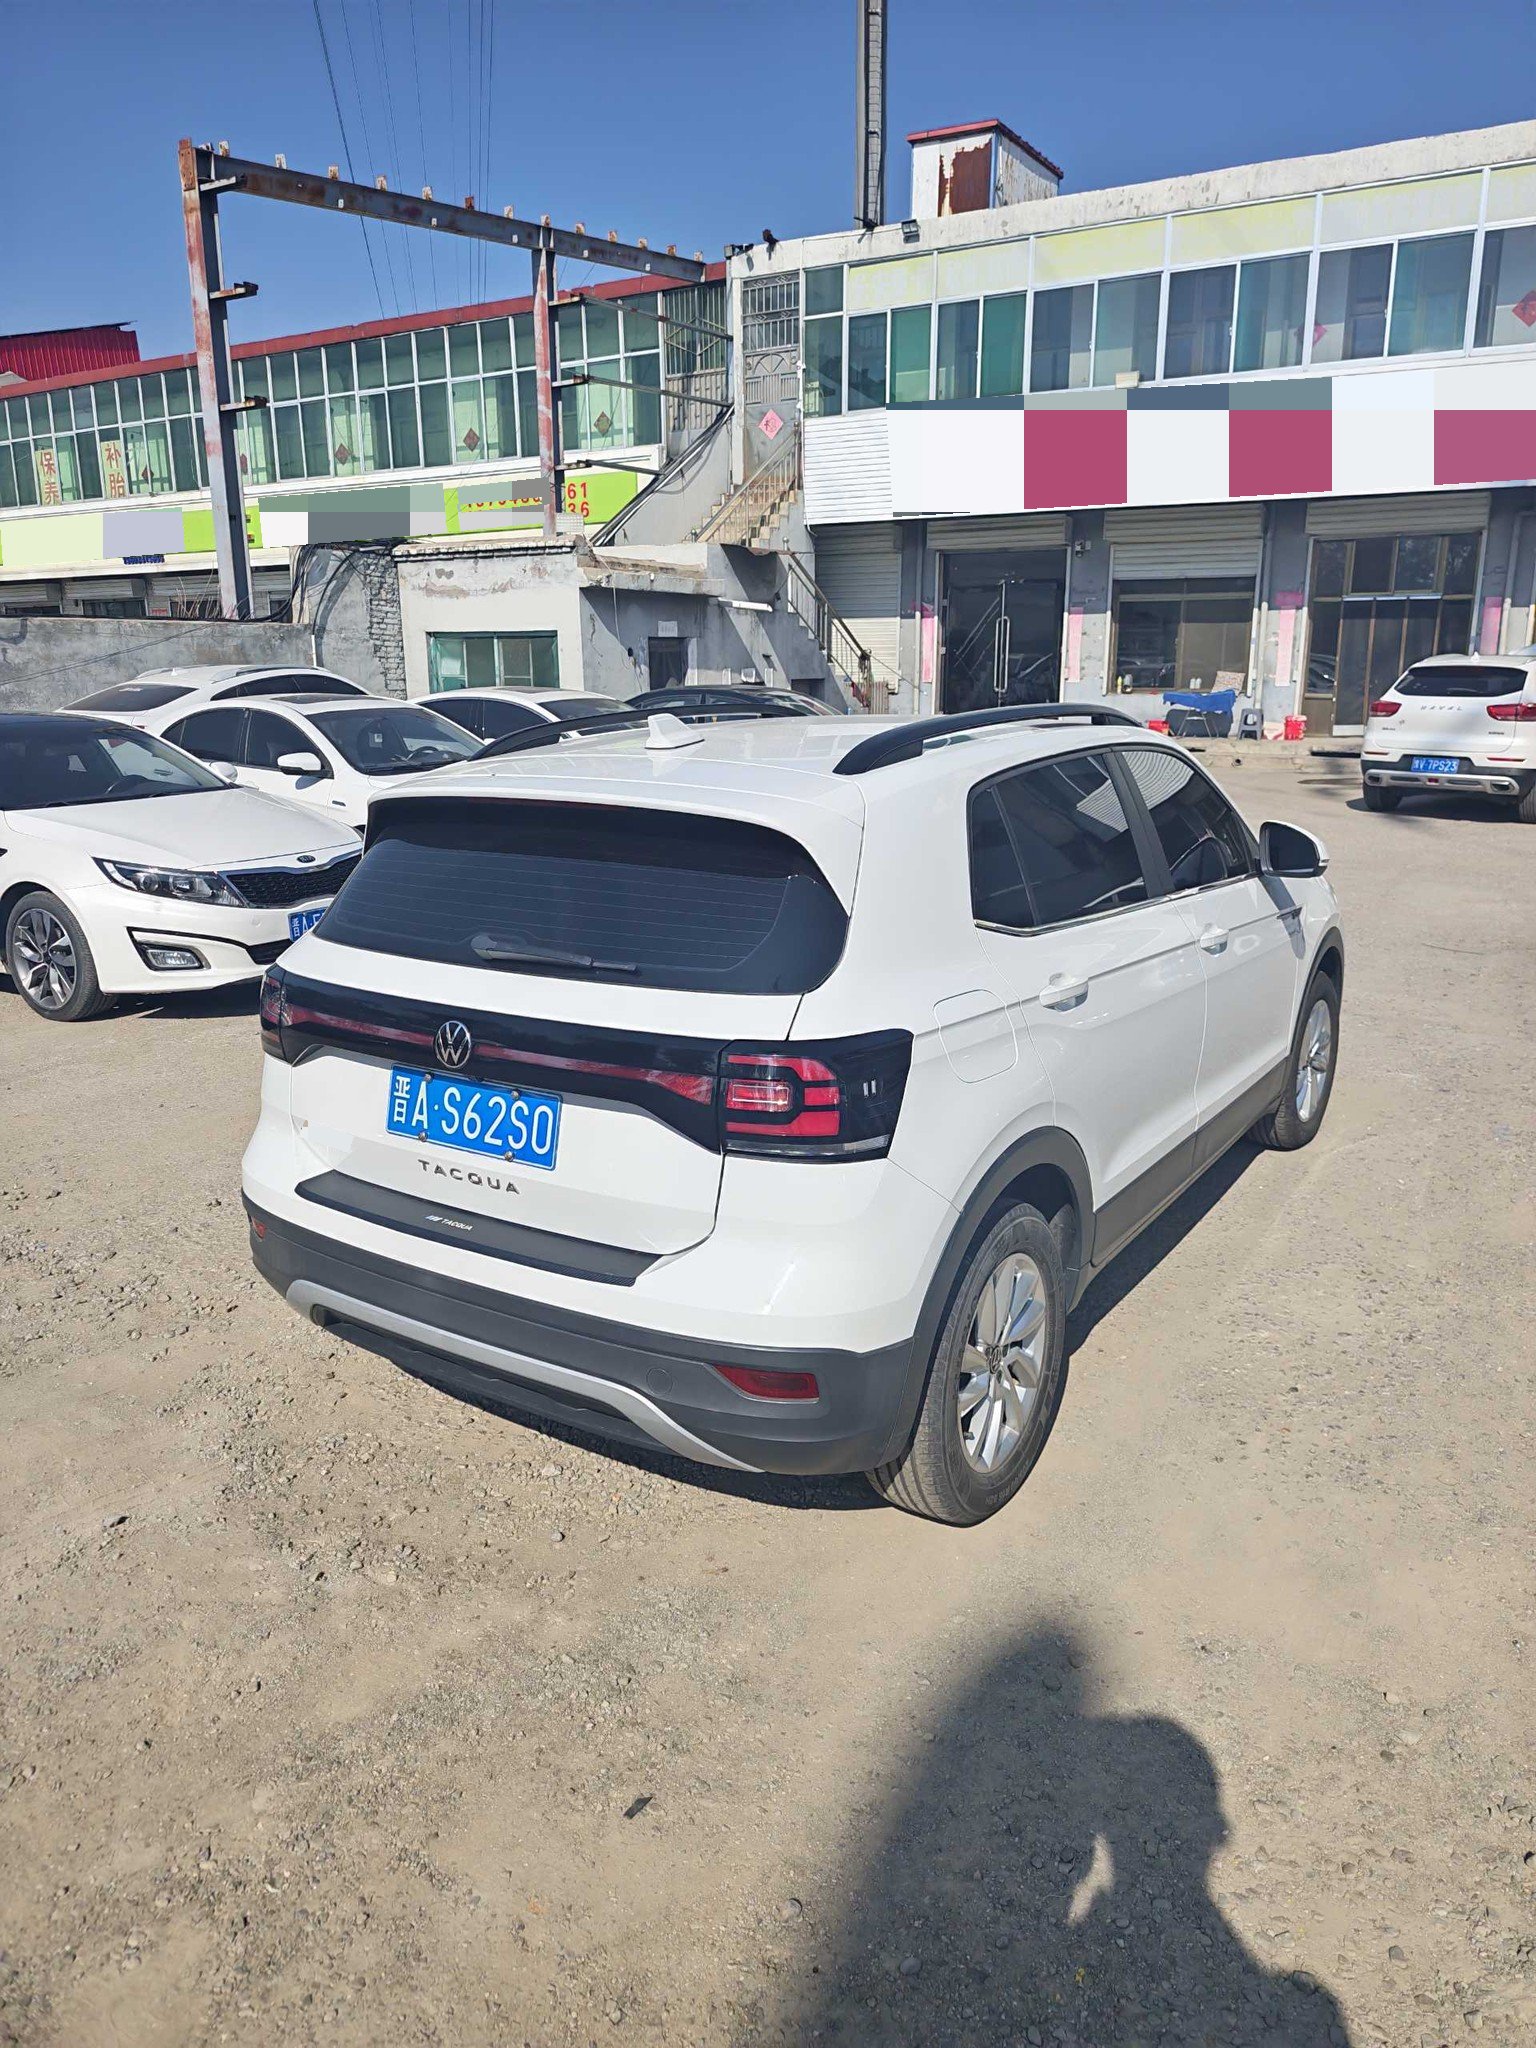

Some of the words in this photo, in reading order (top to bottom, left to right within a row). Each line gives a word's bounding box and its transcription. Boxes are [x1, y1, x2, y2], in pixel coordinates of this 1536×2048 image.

[40, 451, 59, 504] 保养
[105, 442, 125, 498] 补胎
[567, 482, 588, 499] 61
[417, 1159, 520, 1195] TACQUA
